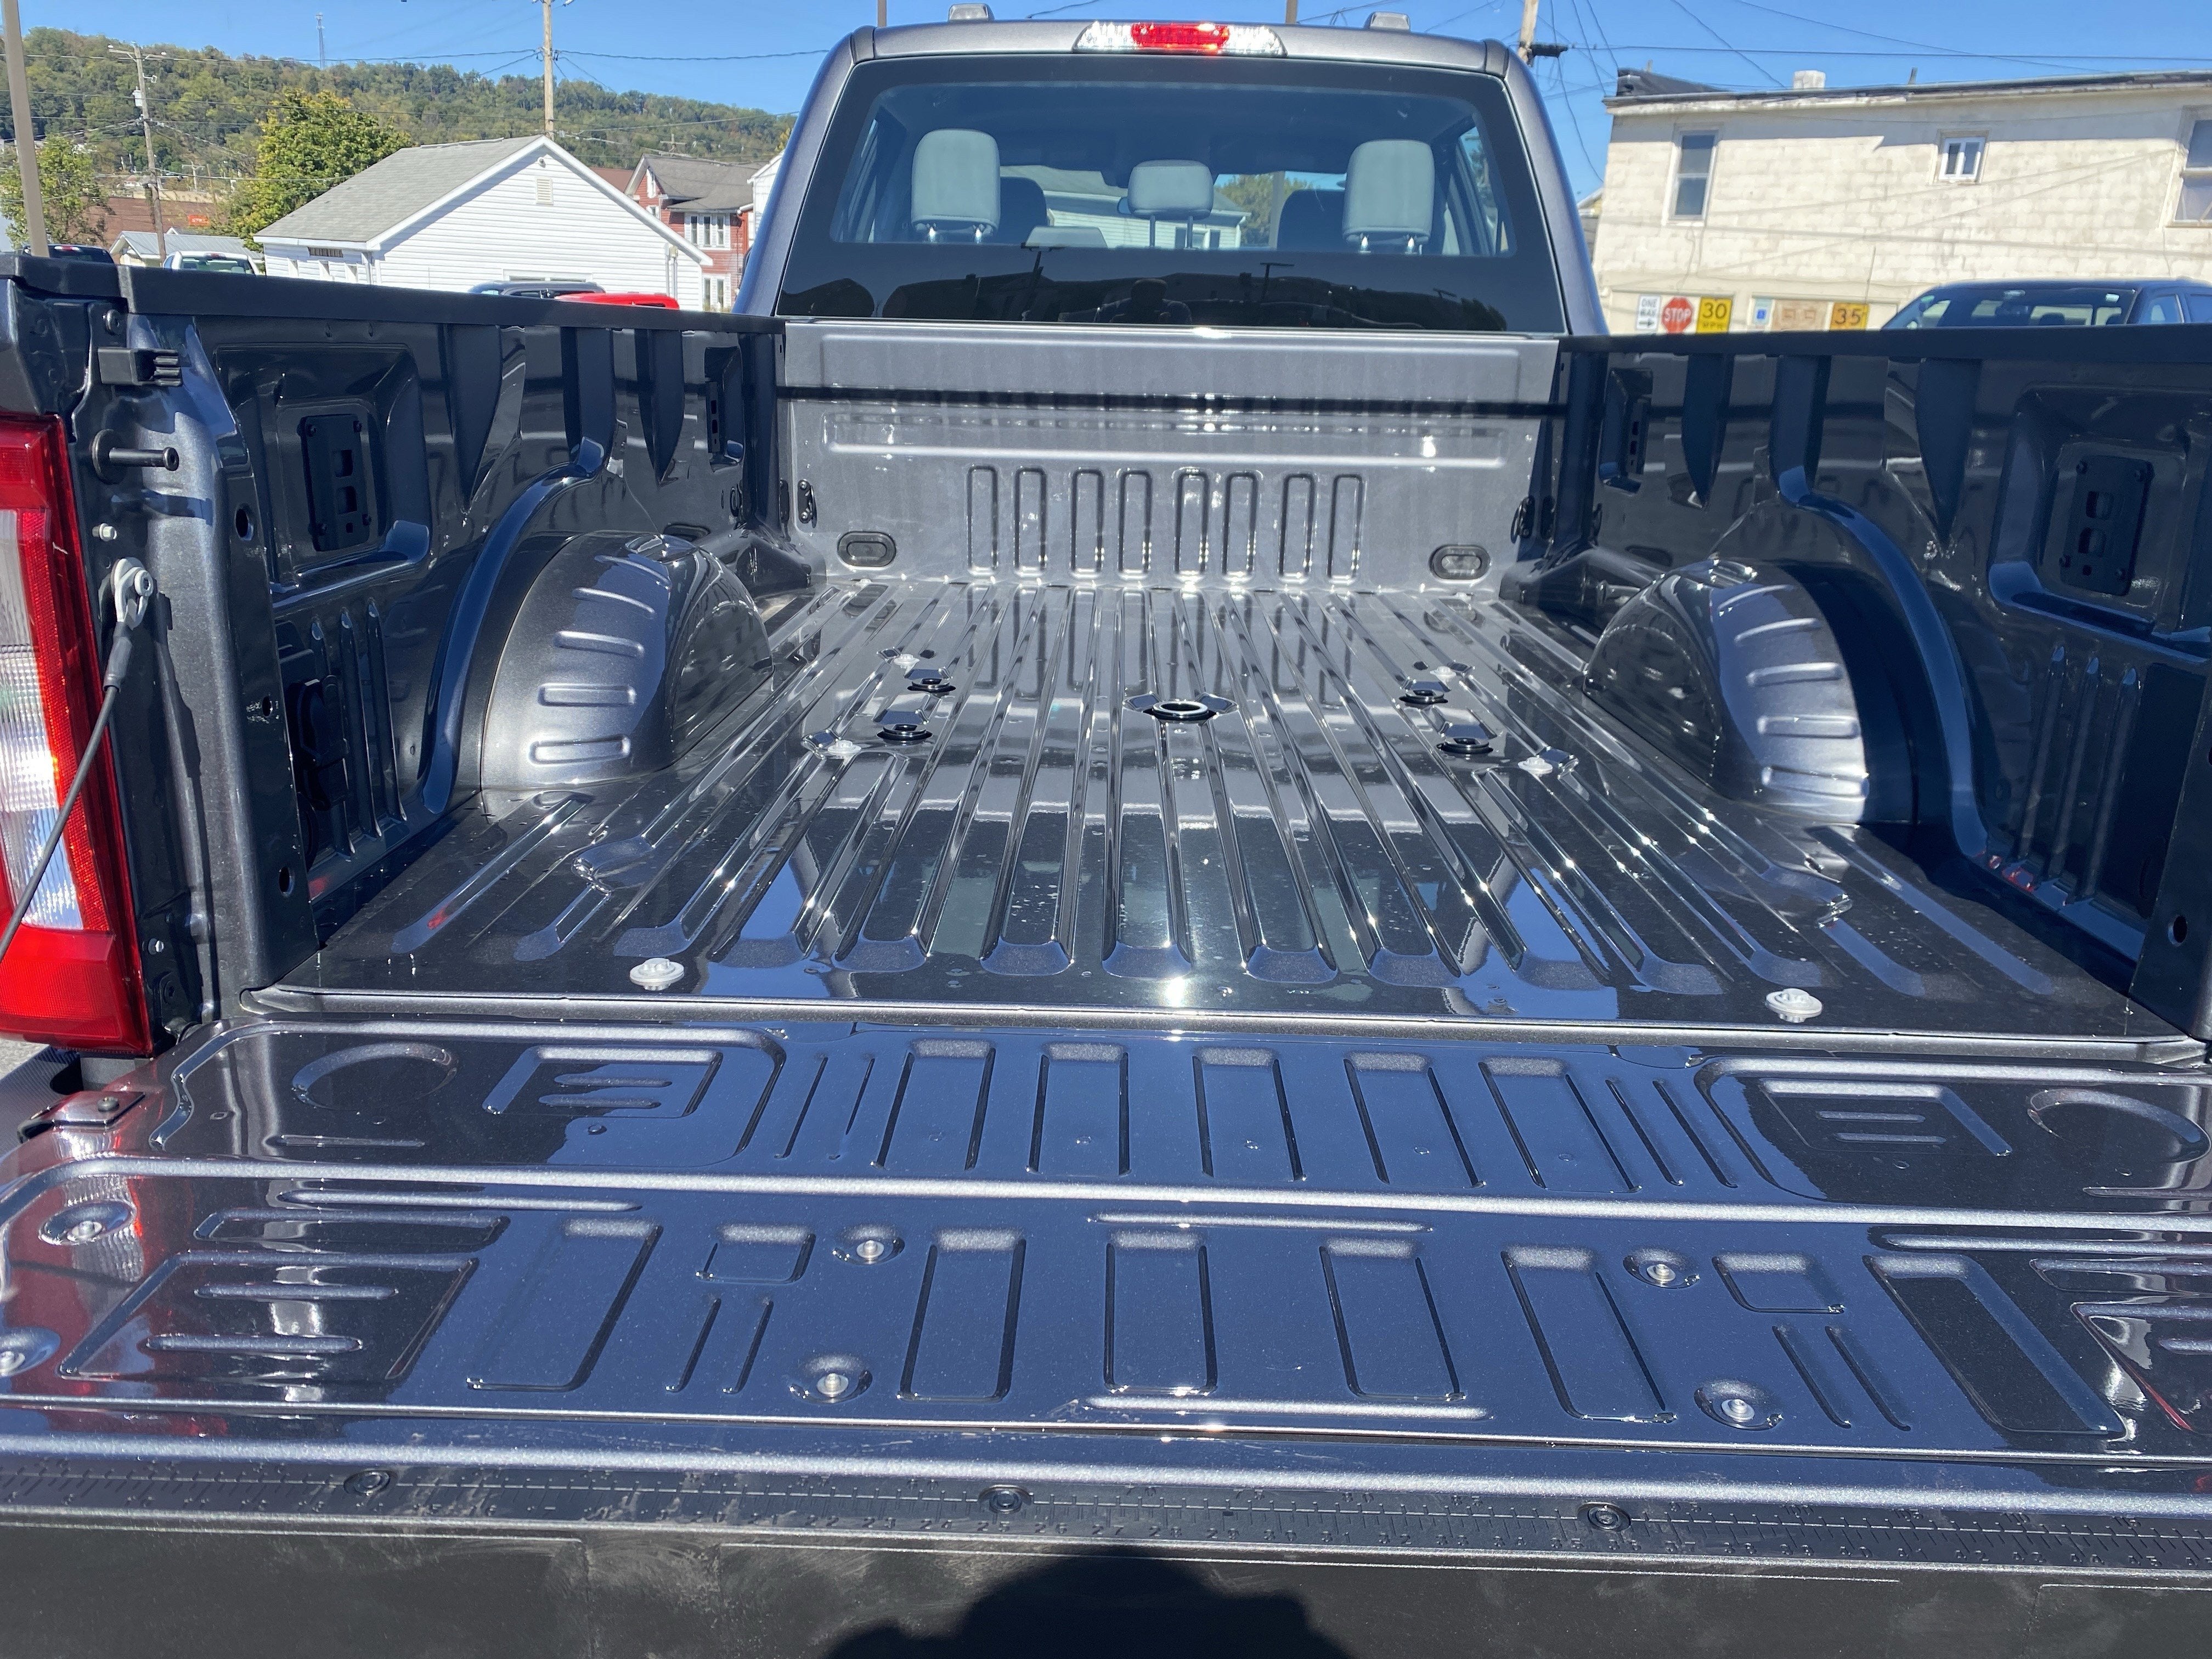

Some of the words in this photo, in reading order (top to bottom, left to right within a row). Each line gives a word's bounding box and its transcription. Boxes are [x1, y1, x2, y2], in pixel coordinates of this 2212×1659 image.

[1664, 308, 1691, 321] STOP
[1702, 302, 1727, 319] 30
[1835, 308, 1861, 325] 35
